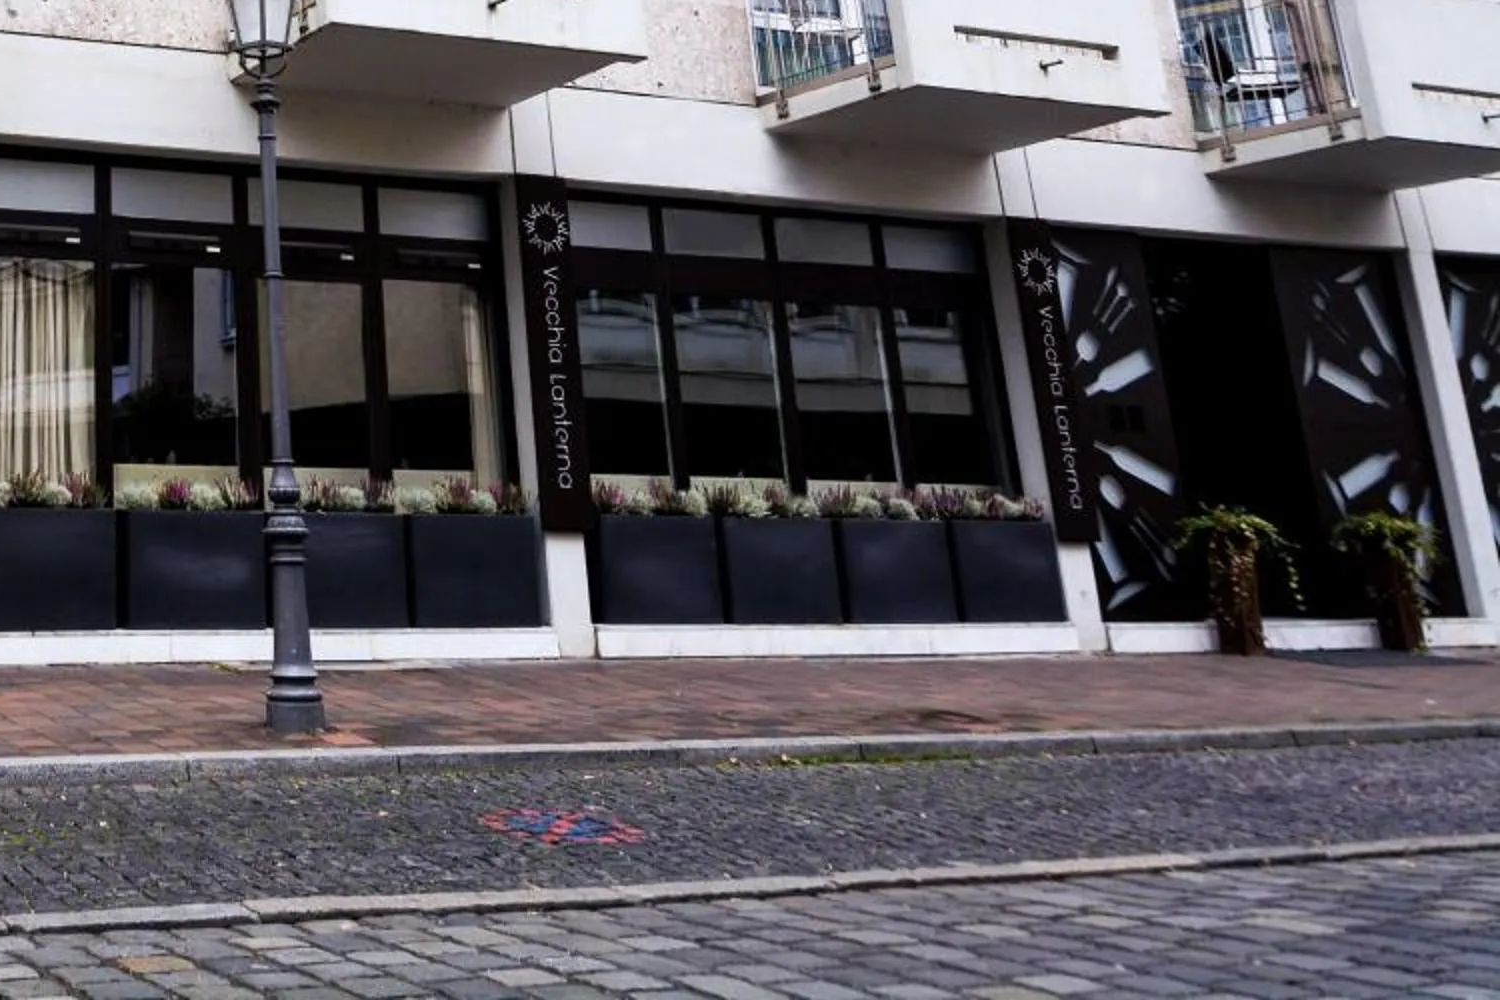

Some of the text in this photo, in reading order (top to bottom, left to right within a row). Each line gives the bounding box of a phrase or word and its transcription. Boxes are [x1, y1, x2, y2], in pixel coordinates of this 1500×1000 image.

[542, 264, 574, 490] Vecchia Lanterna
[1037, 304, 1084, 511] Vecchia Lanterna
